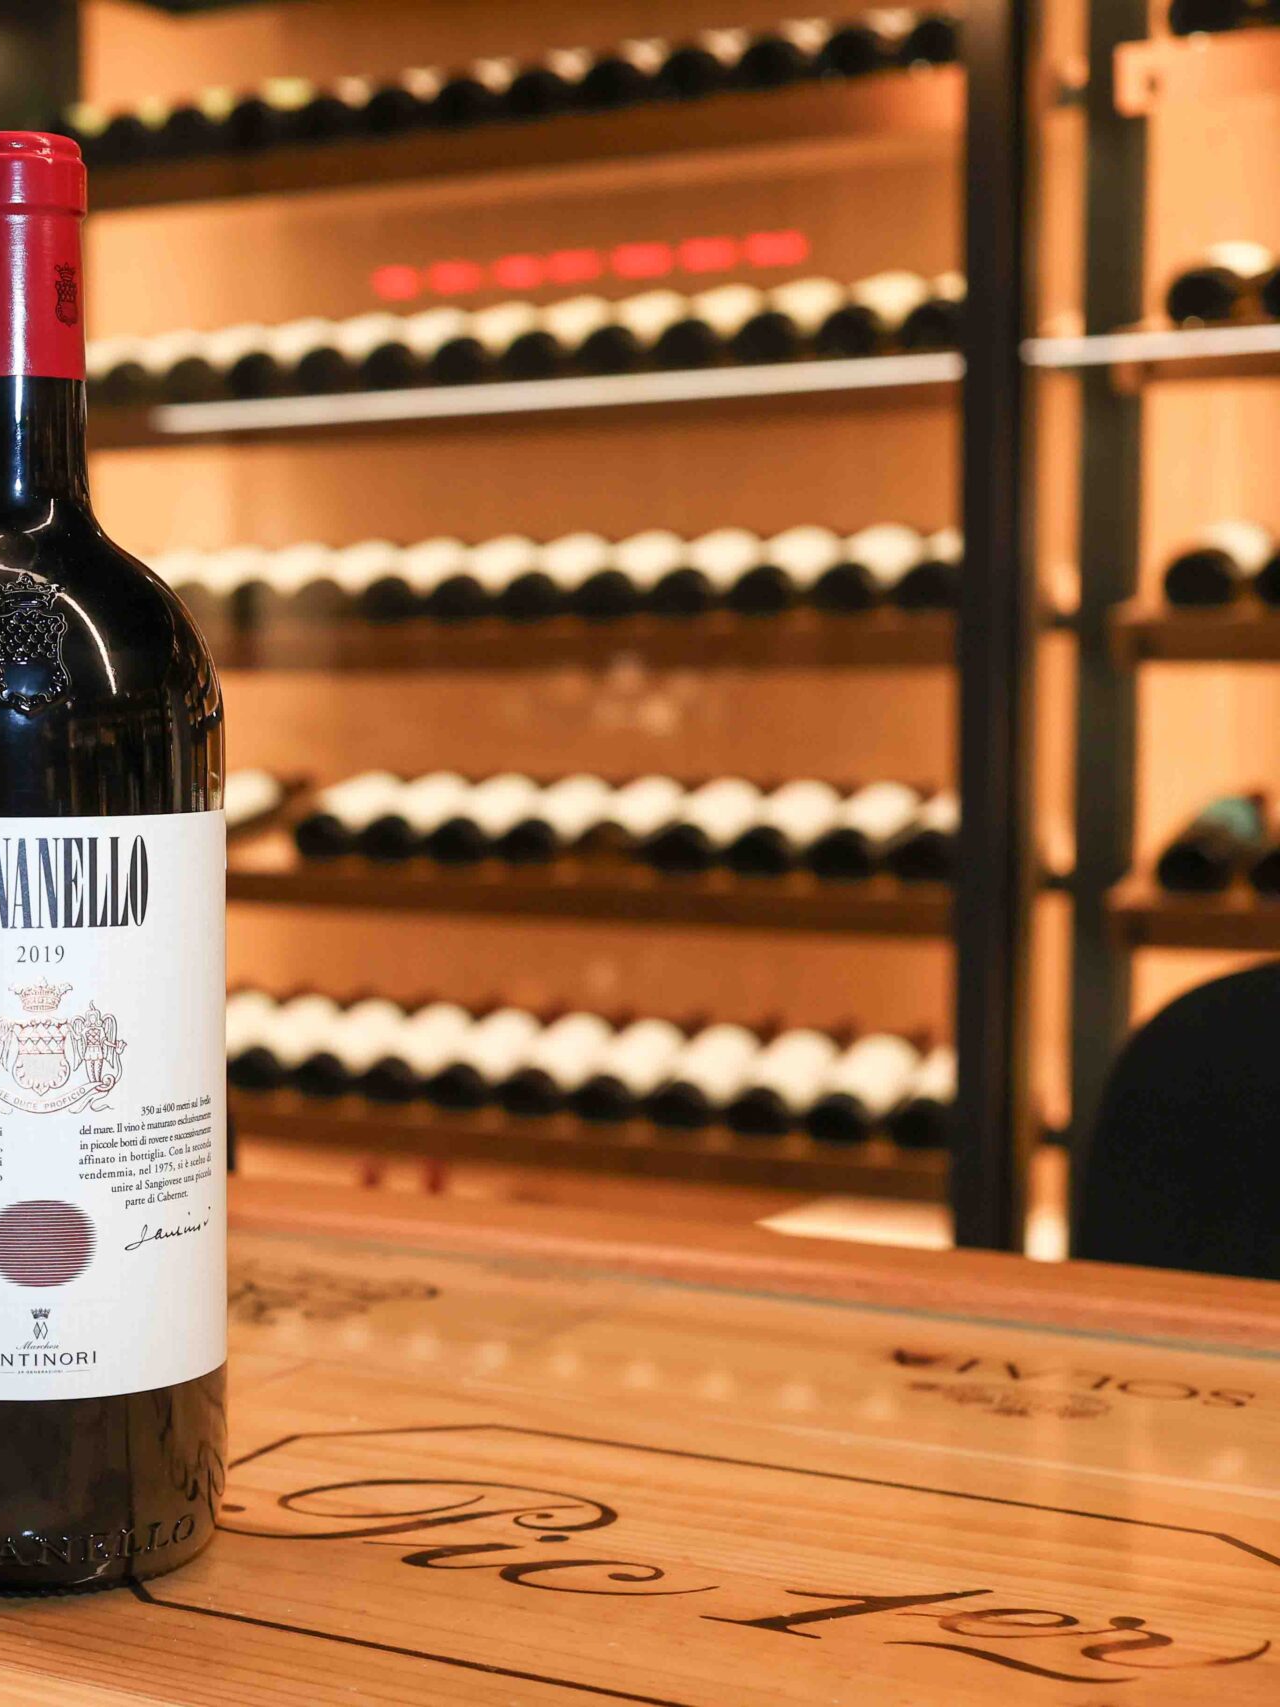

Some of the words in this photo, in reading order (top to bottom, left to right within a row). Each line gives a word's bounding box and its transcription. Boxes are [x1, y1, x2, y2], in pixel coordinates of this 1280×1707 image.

[16, 945, 65, 963] 2019
[141, 1106, 155, 1116] 350
[156, 1104, 162, 1114] ai
[162, 1102, 175, 1113] 400
[79, 1125, 92, 1135] del
[93, 1126, 115, 1135] mare.
[117, 1123, 123, 1133] Il
[124, 1122, 140, 1131] vino
[147, 1120, 177, 1130] maturato
[80, 1140, 89, 1150] in
[90, 1138, 118, 1152] piccole
[120, 1136, 138, 1147] botti
[139, 1135, 147, 1146] di
[148, 1136, 168, 1144] rovere
[79, 1153, 116, 1165] affinato
[118, 1152, 127, 1162] in
[130, 1148, 166, 1162] bottiglia.
[169, 1146, 183, 1156] Con
[185, 1144, 191, 1153] la
[79, 1167, 136, 1180] vendemmia,
[139, 1164, 151, 1175] nel
[155, 1161, 176, 1173] 1975,
[177, 1159, 183, 1169] si
[111, 1182, 134, 1193] unire
[135, 1180, 143, 1190] al
[145, 1176, 182, 1191] Sangiovese
[183, 1175, 194, 1183] una
[125, 1196, 145, 1209] parte
[147, 1193, 155, 1204] di
[157, 1190, 189, 1203] Cabernet.
[16, 1340, 60, 1350] Marchesi
